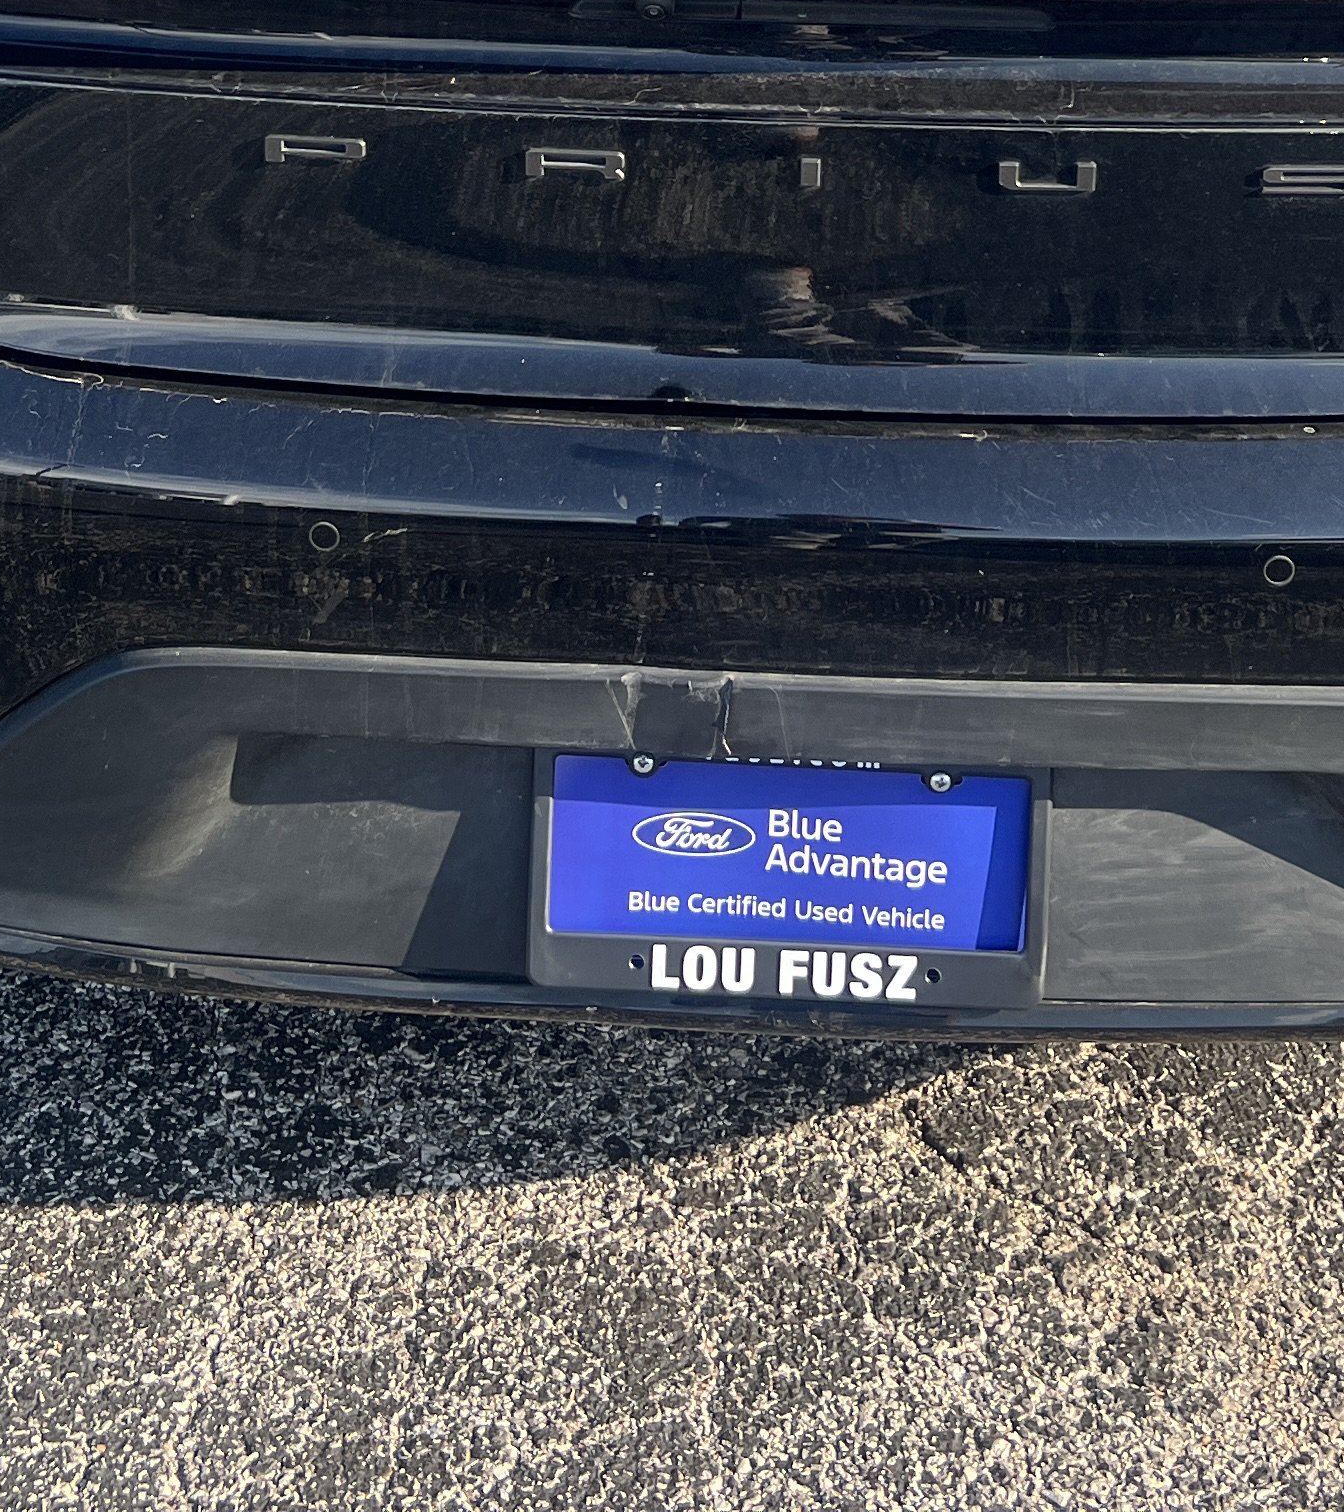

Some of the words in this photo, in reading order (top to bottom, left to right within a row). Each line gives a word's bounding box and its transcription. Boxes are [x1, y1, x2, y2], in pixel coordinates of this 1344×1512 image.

[654, 815, 733, 853] Ford
[768, 808, 843, 843] Blue
[764, 843, 949, 890] Advantage
[628, 890, 680, 914] Blue
[687, 892, 786, 919] Certified
[795, 898, 854, 924] Used
[861, 904, 946, 931] Vehicle
[650, 942, 756, 994] LOU
[777, 948, 919, 1001] FUSZ
